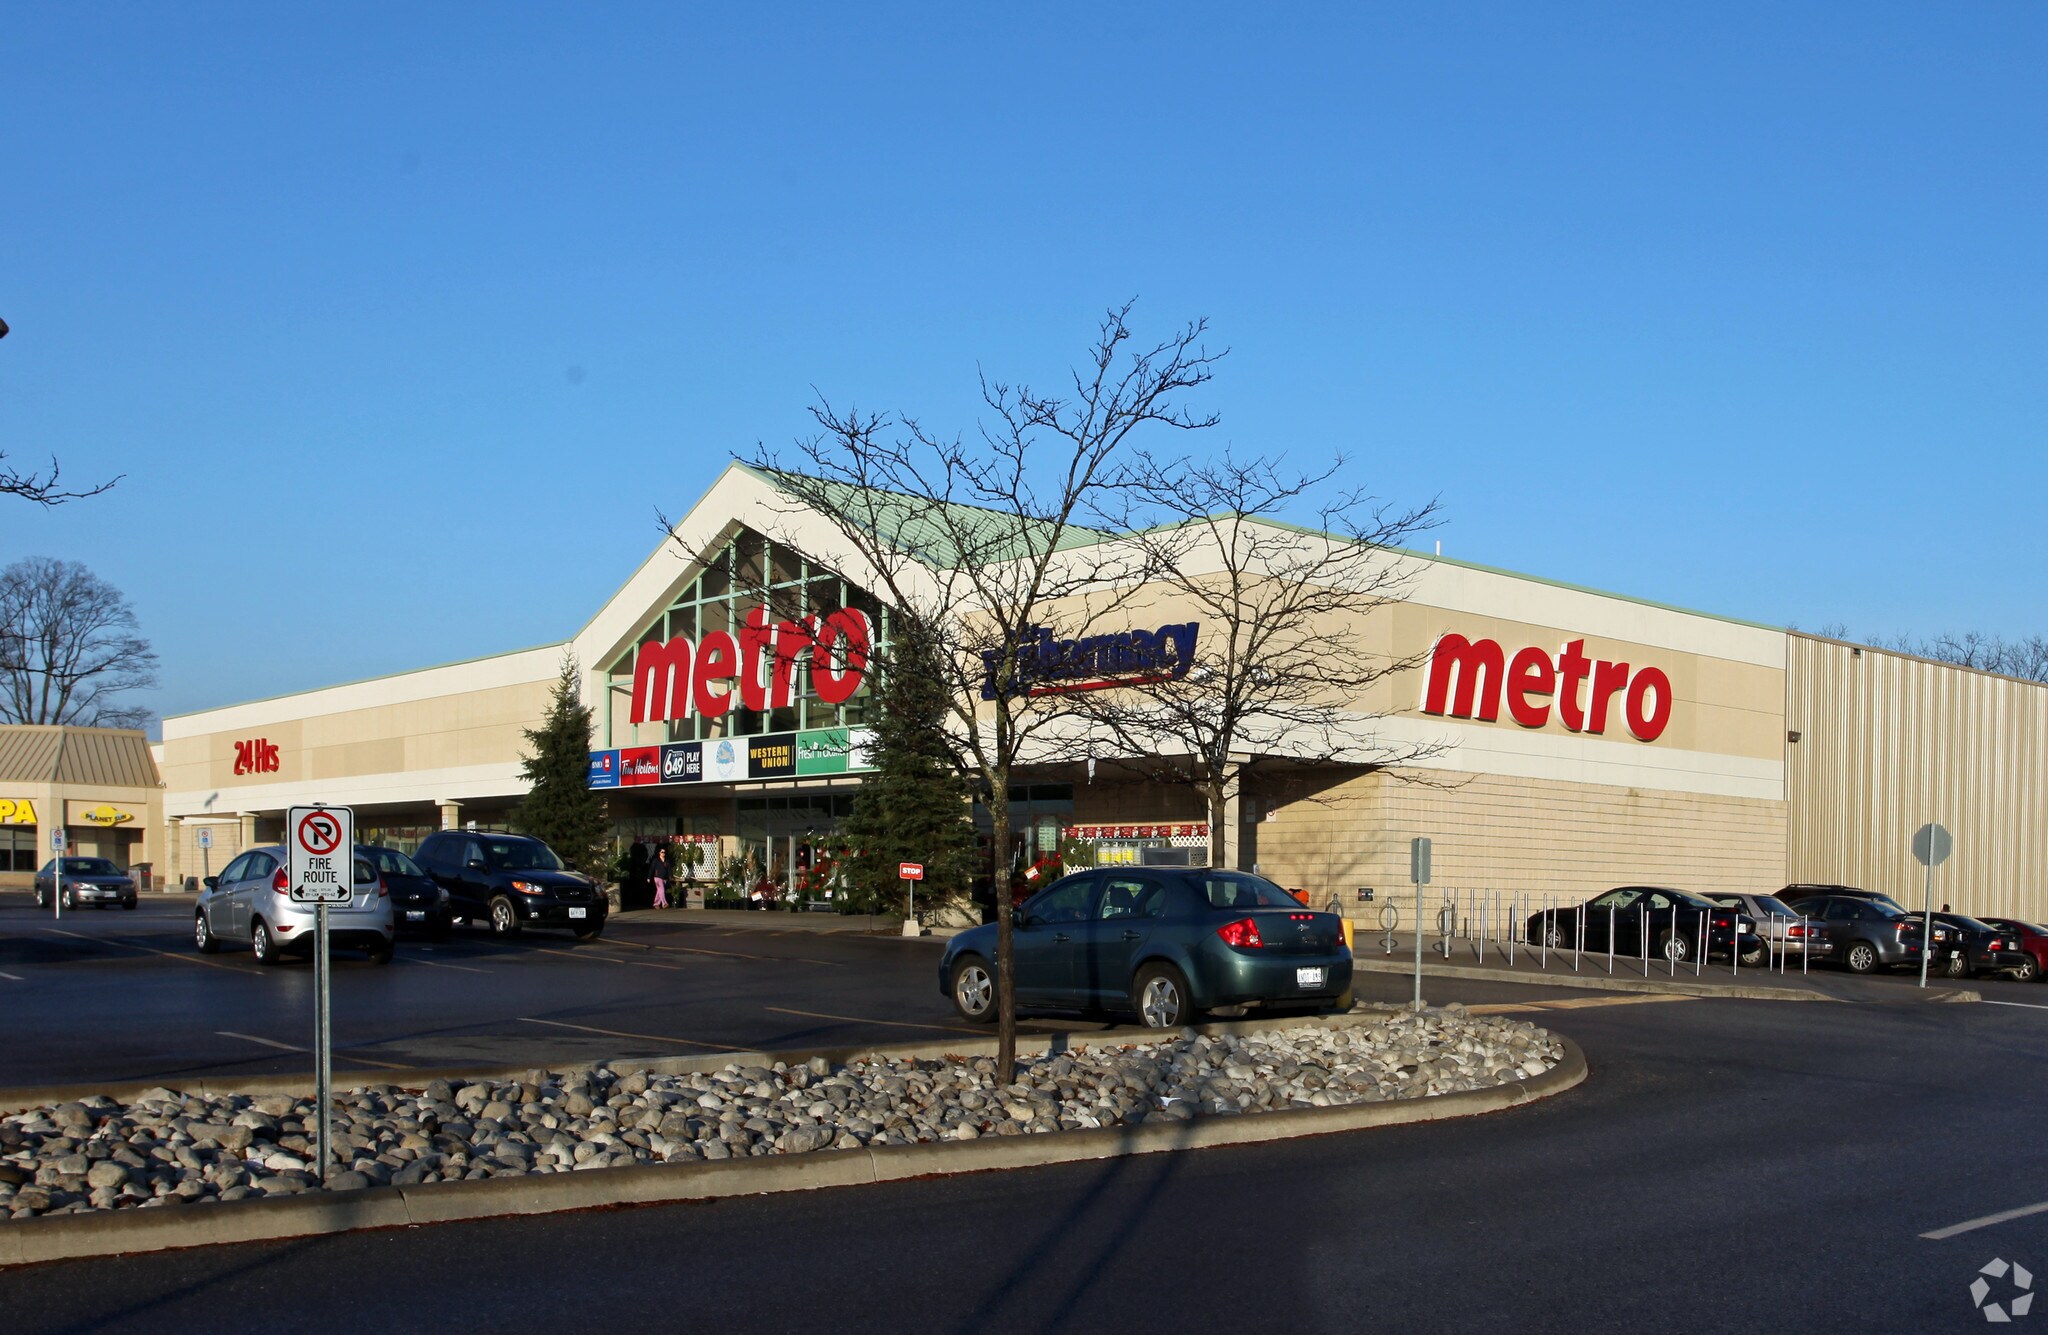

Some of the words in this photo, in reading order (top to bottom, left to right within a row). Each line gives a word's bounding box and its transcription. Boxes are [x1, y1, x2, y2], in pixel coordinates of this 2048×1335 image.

[630, 603, 875, 724] metro
[1419, 633, 1672, 742] metro
[233, 740, 253, 775] 24
[686, 752, 700, 762] PLAY
[750, 745, 788, 759] WESTERN
[634, 758, 658, 775] Hortons
[686, 763, 700, 774] HERE
[761, 757, 788, 768] UNION
[85, 813, 112, 823] PLANET
[114, 814, 128, 822] SUN
[308, 857, 332, 870] FIRE
[303, 871, 338, 883] ROUTE
[902, 867, 921, 875] STOP
